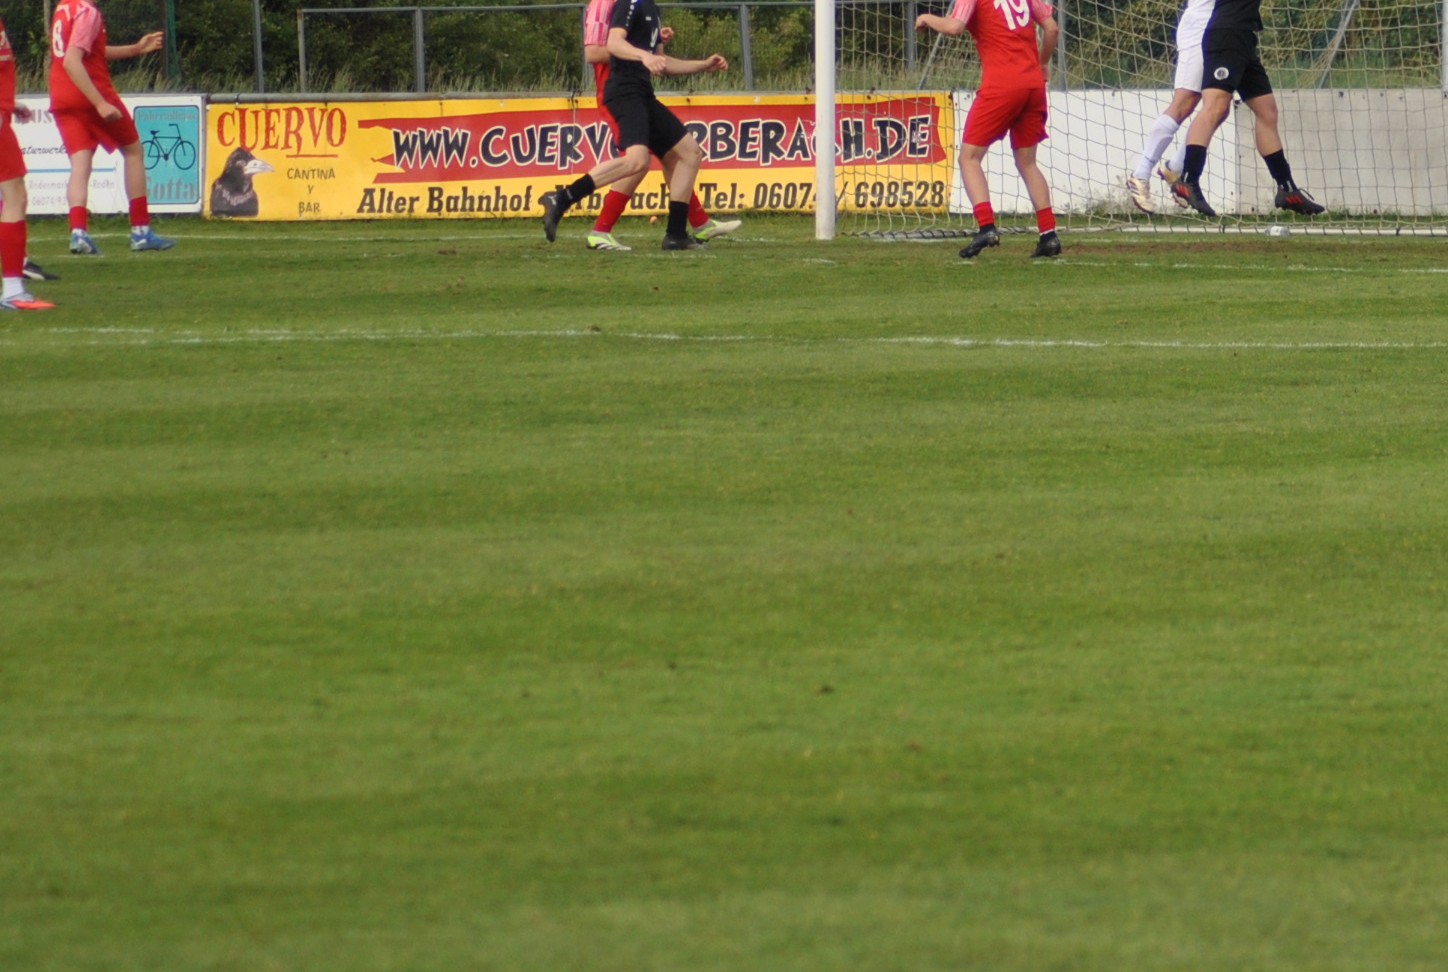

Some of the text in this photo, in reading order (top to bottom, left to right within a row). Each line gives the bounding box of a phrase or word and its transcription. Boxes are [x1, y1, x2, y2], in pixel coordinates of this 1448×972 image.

[217, 107, 347, 154] CUERVO
[287, 168, 336, 179] CANTINA
[308, 184, 314, 194] Y
[357, 187, 420, 214] Alter
[426, 185, 532, 212] Bahnhof
[699, 183, 745, 210] Tel:
[753, 182, 818, 209] 0607
[855, 180, 945, 208] 698528
[299, 202, 320, 213] BAR
